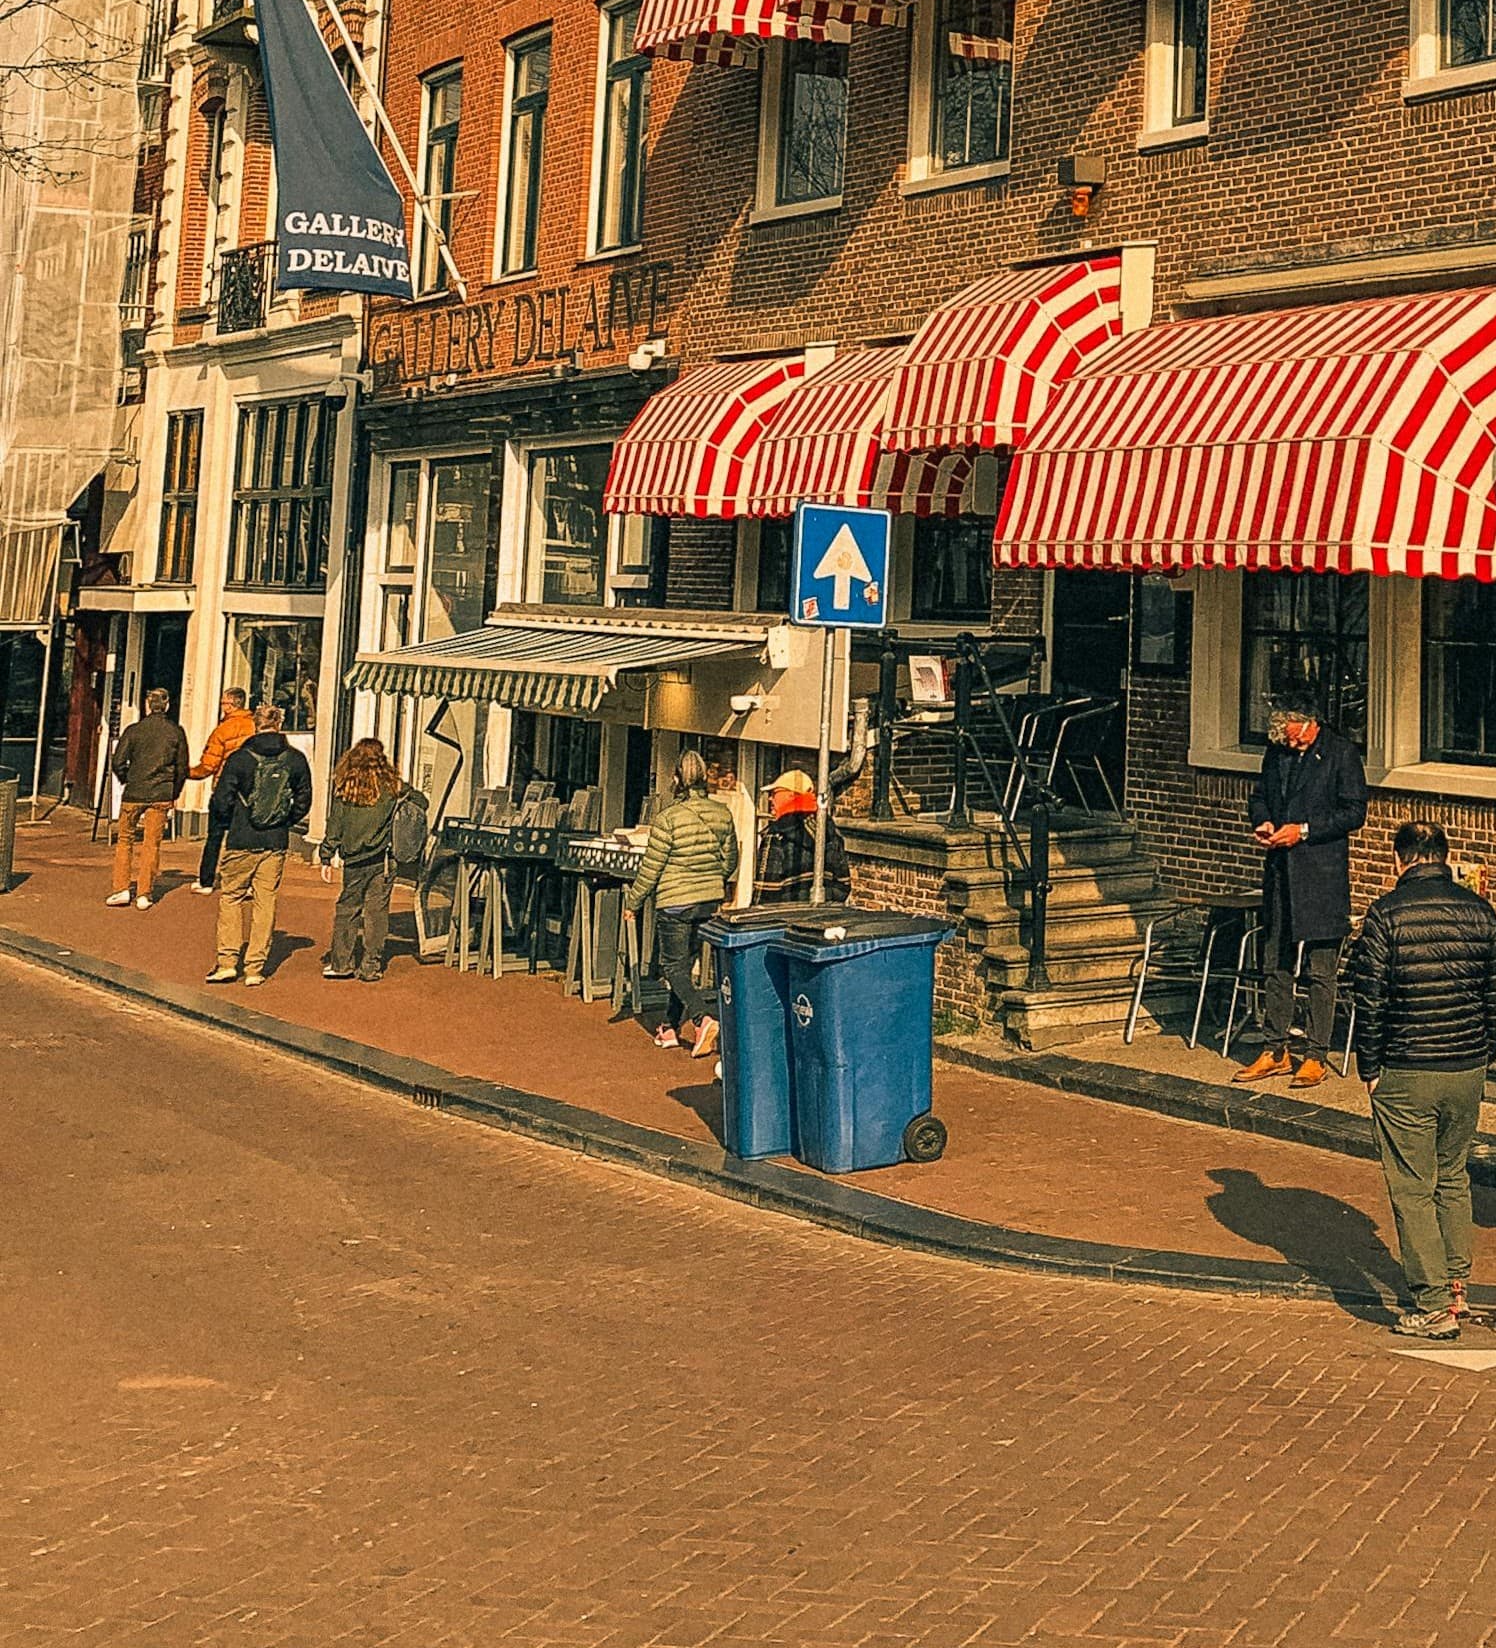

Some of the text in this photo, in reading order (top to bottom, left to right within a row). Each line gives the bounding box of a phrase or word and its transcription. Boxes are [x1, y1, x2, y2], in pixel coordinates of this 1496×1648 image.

[284, 211, 405, 248] GALLERY
[287, 248, 410, 283] DELAIVE
[370, 260, 673, 387] GALLERY DELAIVE
